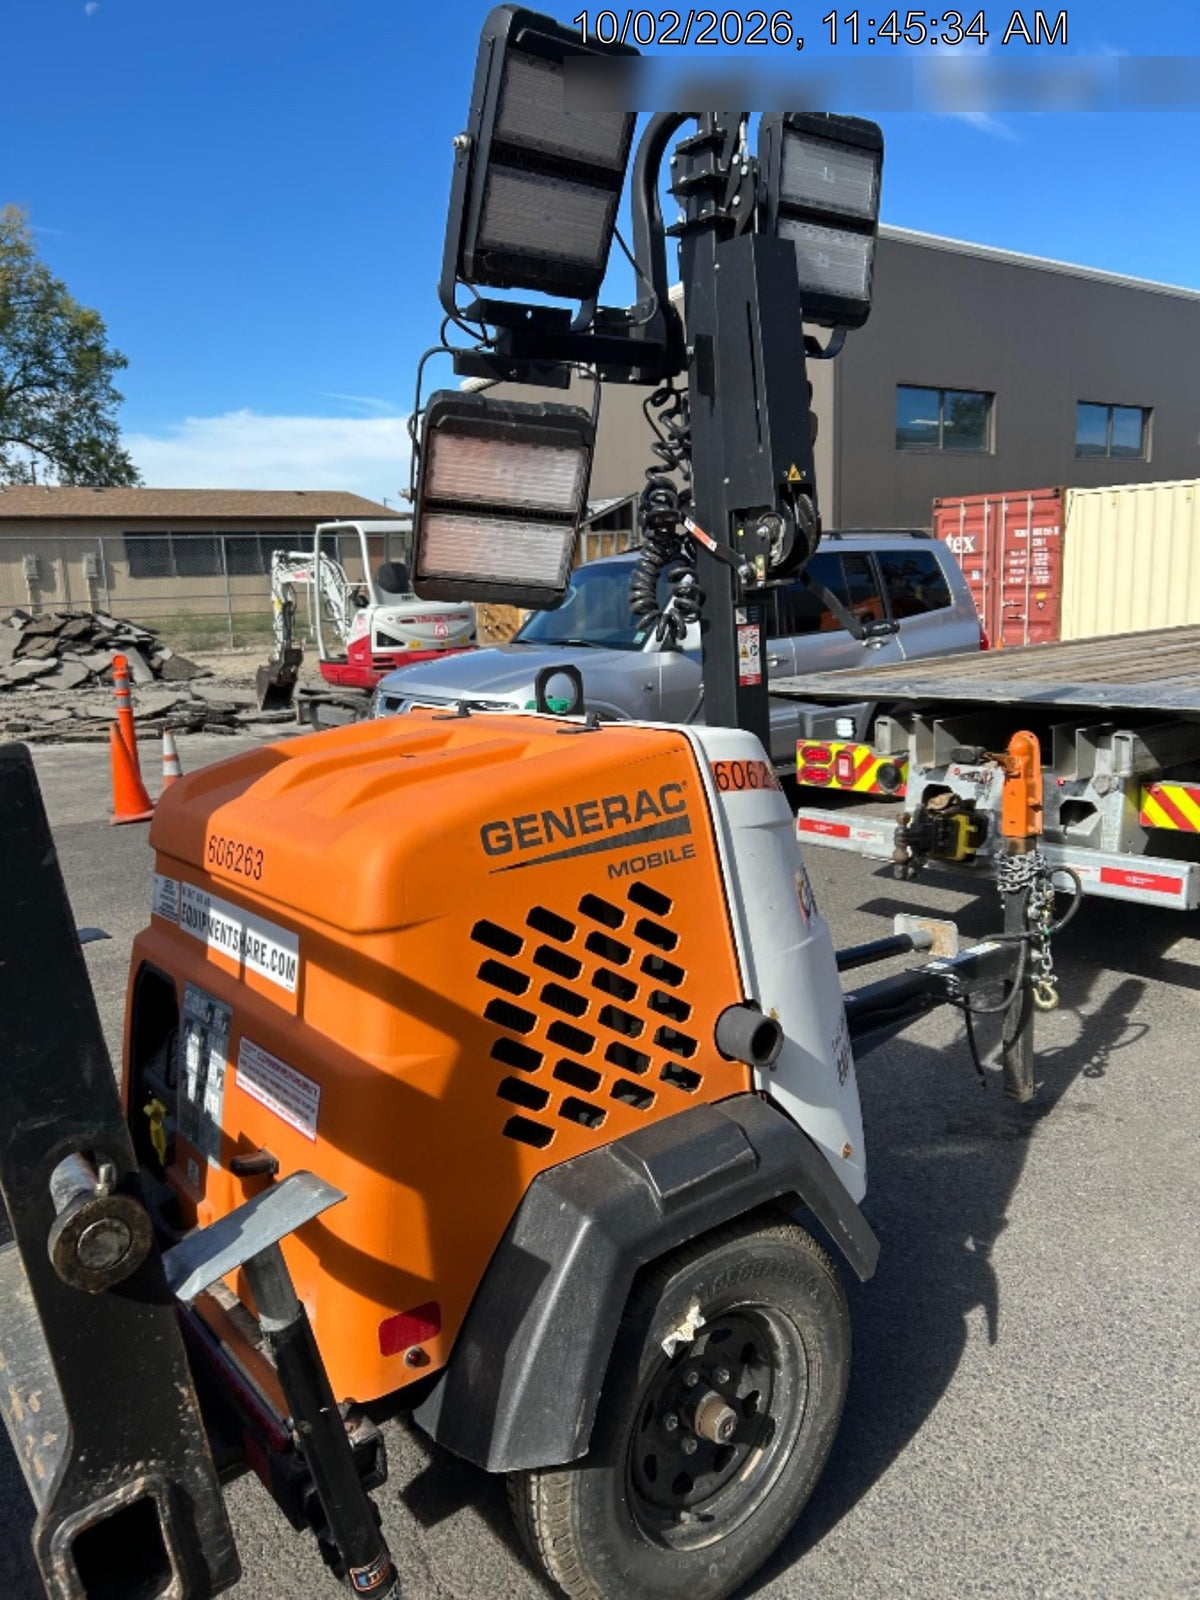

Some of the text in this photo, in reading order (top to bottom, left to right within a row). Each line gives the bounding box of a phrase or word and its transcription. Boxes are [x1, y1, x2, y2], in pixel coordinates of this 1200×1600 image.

[480, 783, 687, 856] GENERAC
[208, 835, 264, 881] 606263
[607, 844, 696, 879] MOBILE
